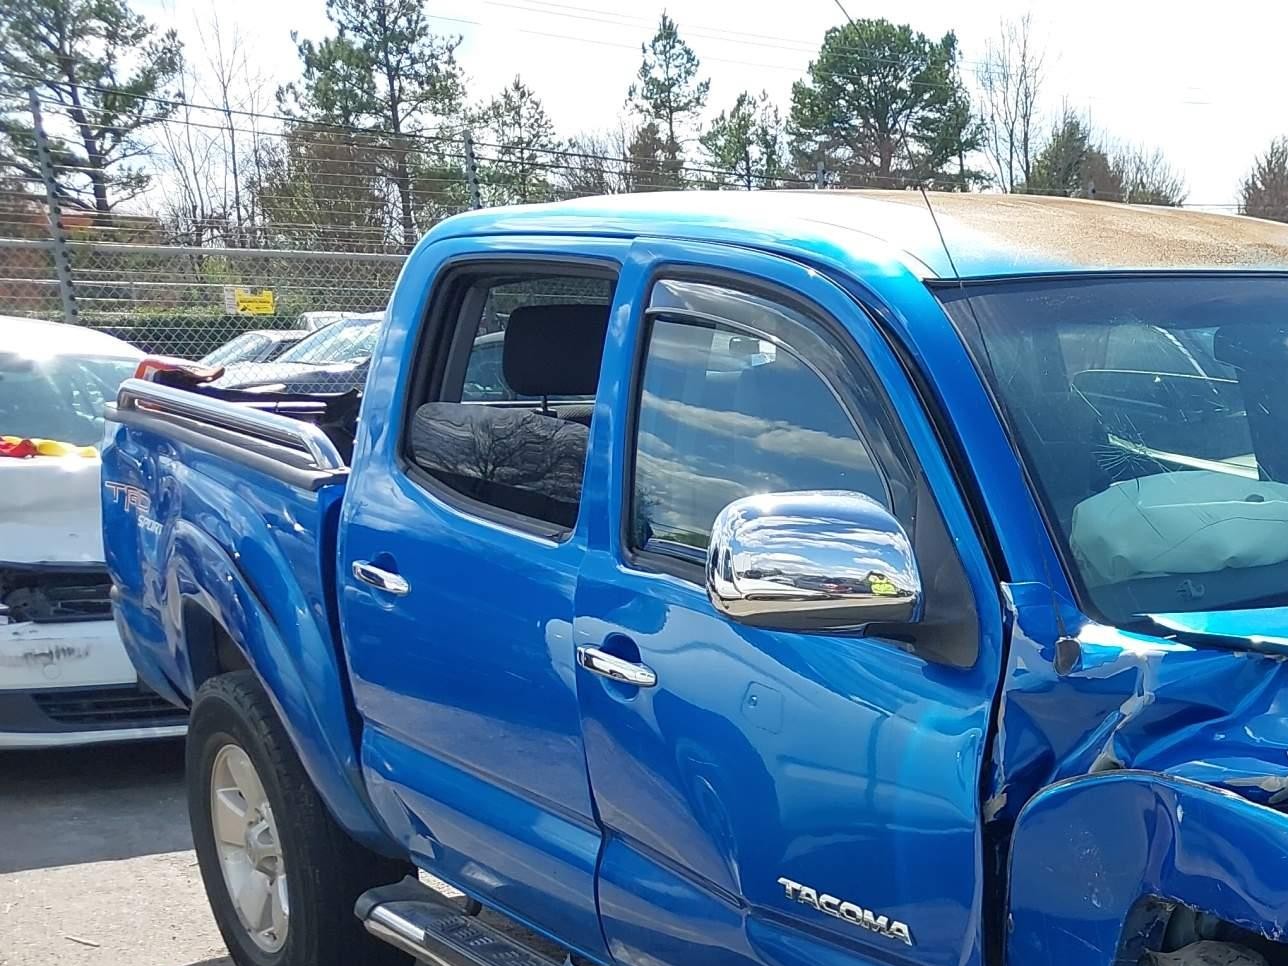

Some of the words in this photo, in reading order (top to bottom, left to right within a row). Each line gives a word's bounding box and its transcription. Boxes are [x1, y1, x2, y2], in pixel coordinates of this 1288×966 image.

[105, 481, 151, 513] TRD
[137, 515, 164, 535] SPORT
[777, 876, 913, 947] TACOMA
